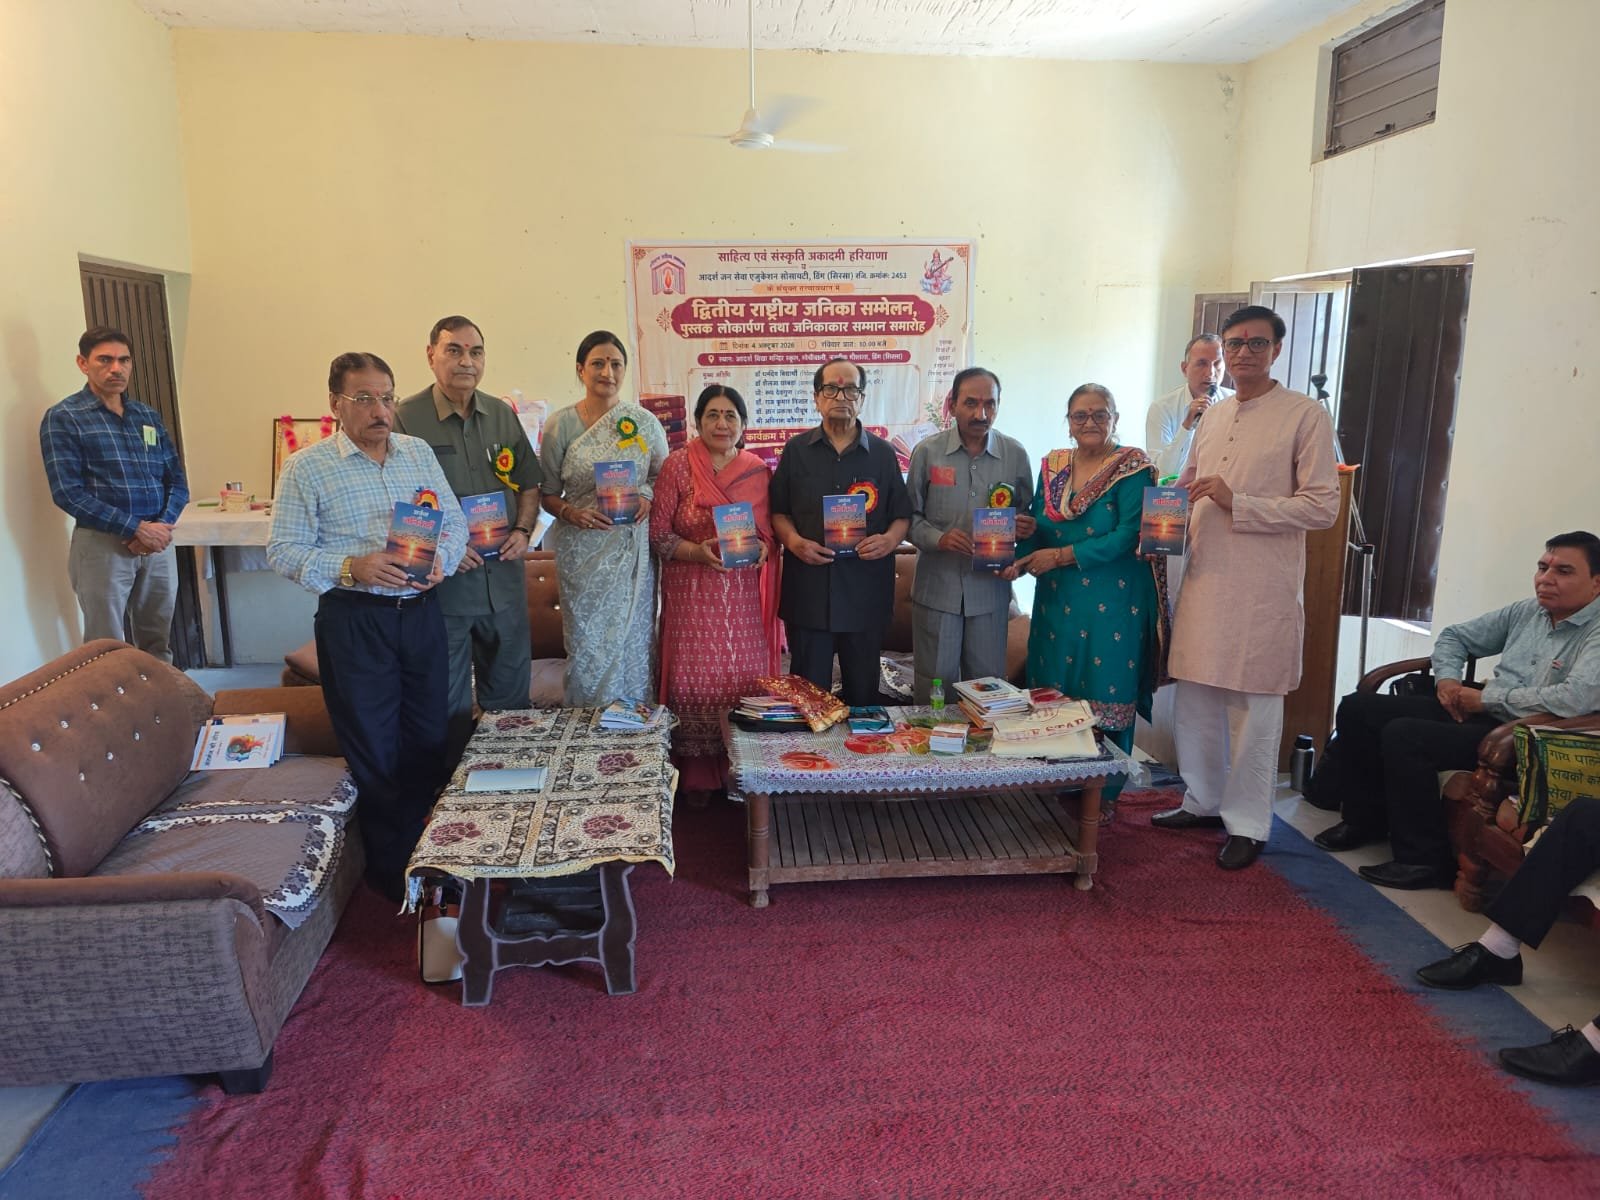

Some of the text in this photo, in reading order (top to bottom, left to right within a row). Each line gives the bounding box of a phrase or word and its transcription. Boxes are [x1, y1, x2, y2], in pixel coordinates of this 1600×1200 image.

[718, 248, 888, 264] साहित्य एवं संस्कृति अकादमी हरियाणा
[698, 271, 718, 281] आदर्श
[720, 273, 732, 281] जन
[734, 271, 747, 280] सेवा
[749, 272, 778, 282] एजुकेशन
[813, 270, 825, 280] डिंग
[827, 271, 854, 280] (सिरसा)
[691, 297, 918, 320] द्वितीय राष्ट्रीय जनिका सम्मेलन,
[680, 317, 926, 338] पुस्तक लोकार्पण तथा जनिकाकार सम्मान समारोह
[744, 430, 777, 441] कार्यक्रम
[1550, 750, 1571, 762] गाय
[1547, 784, 1572, 801] सेवा
